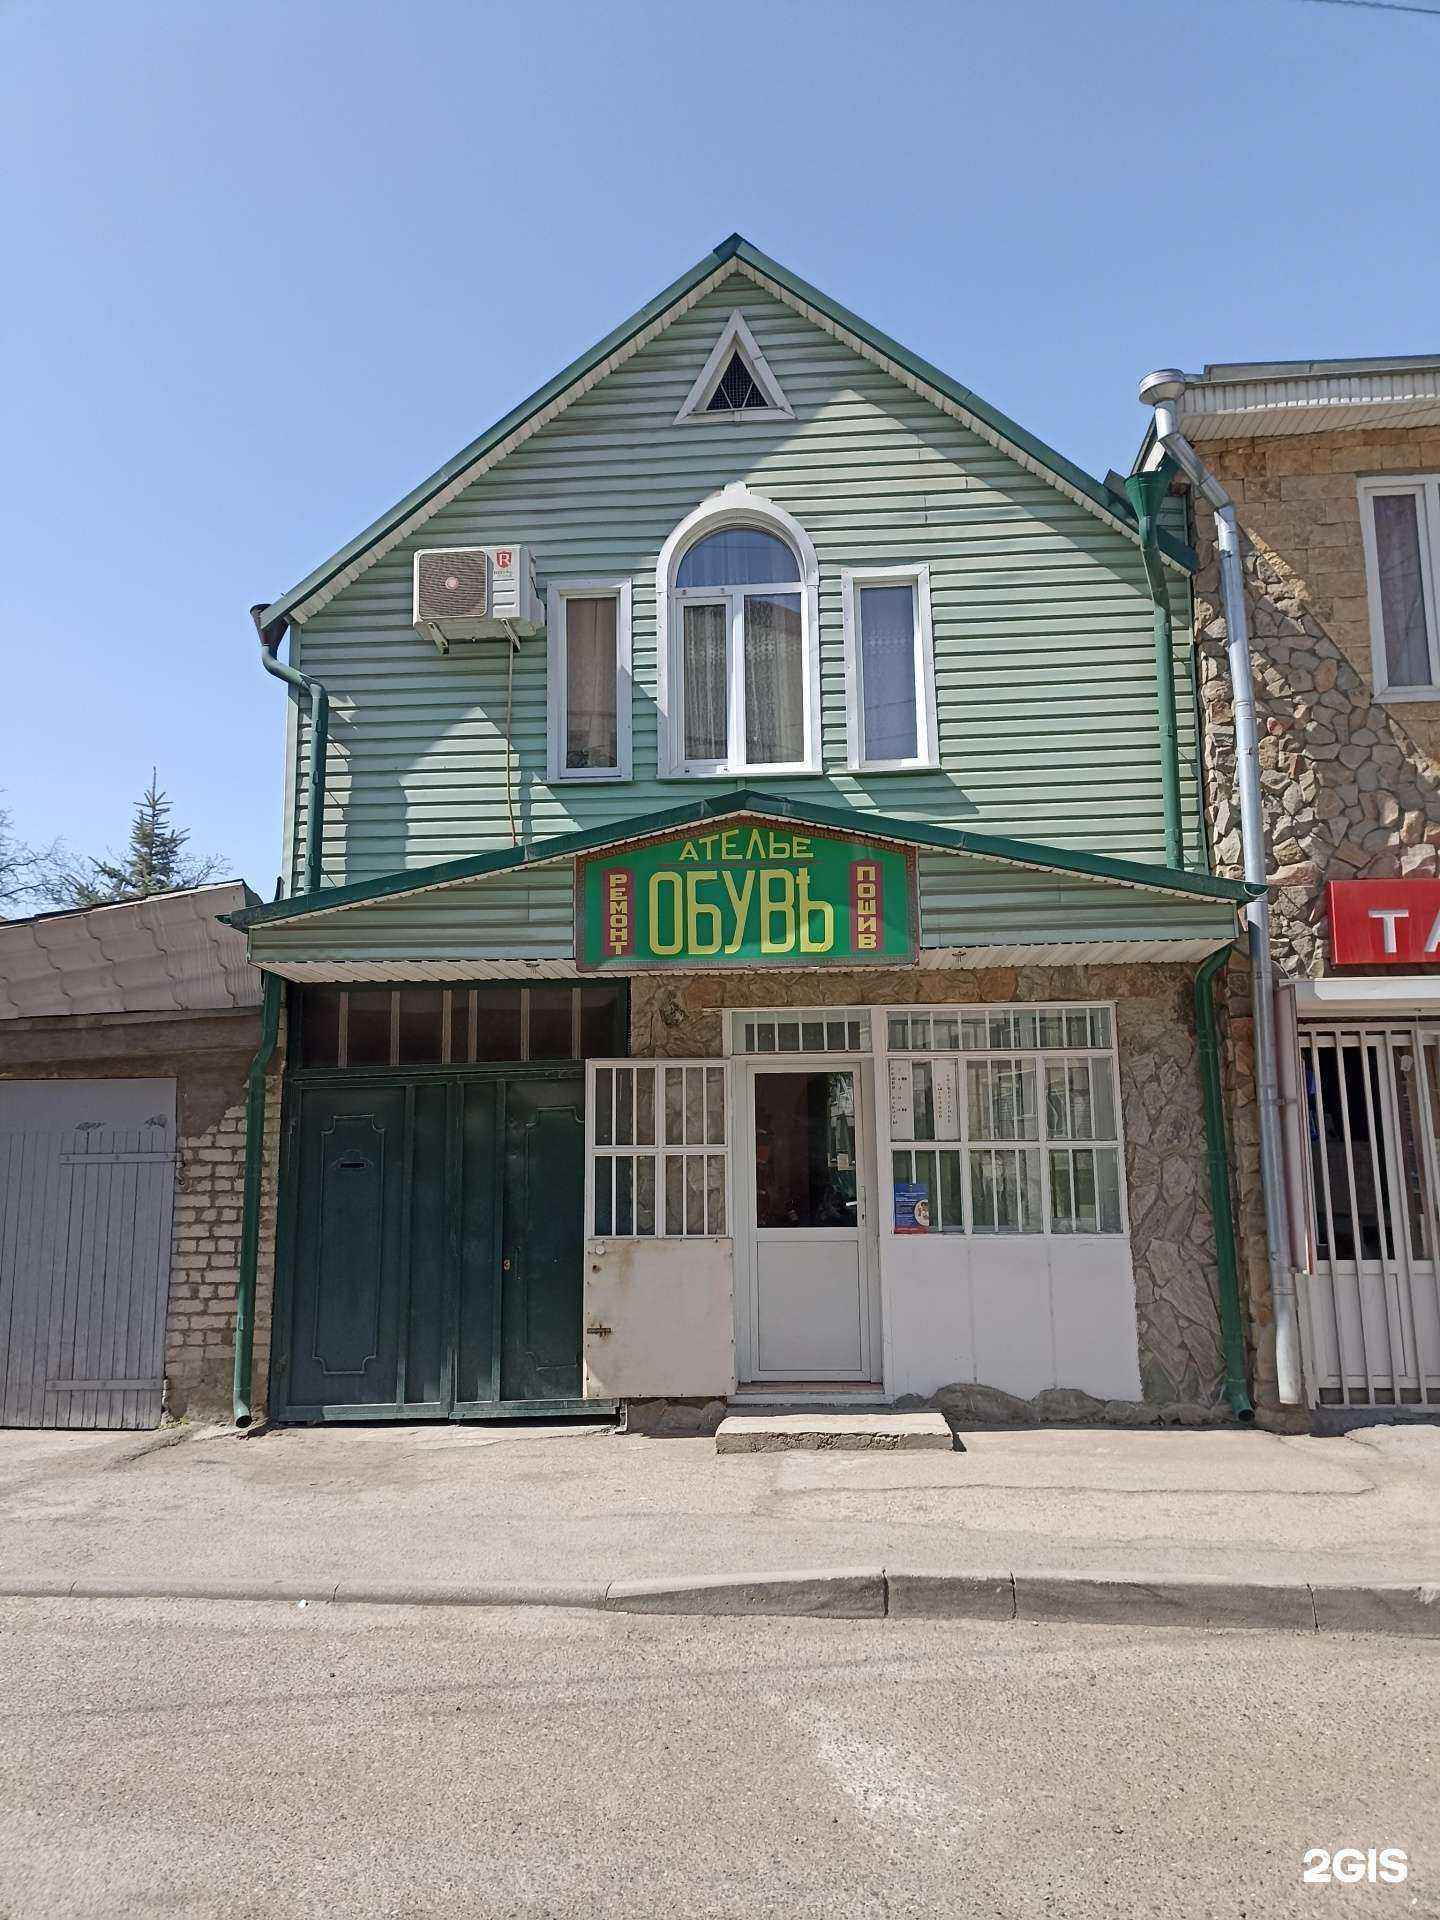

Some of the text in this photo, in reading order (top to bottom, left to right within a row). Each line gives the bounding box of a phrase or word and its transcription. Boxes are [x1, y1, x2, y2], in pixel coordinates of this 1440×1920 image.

[679, 828, 815, 862] АТЕЛЬЕ
[608, 873, 629, 955] РЕМОНТ
[855, 865, 877, 950] ПОШИВ
